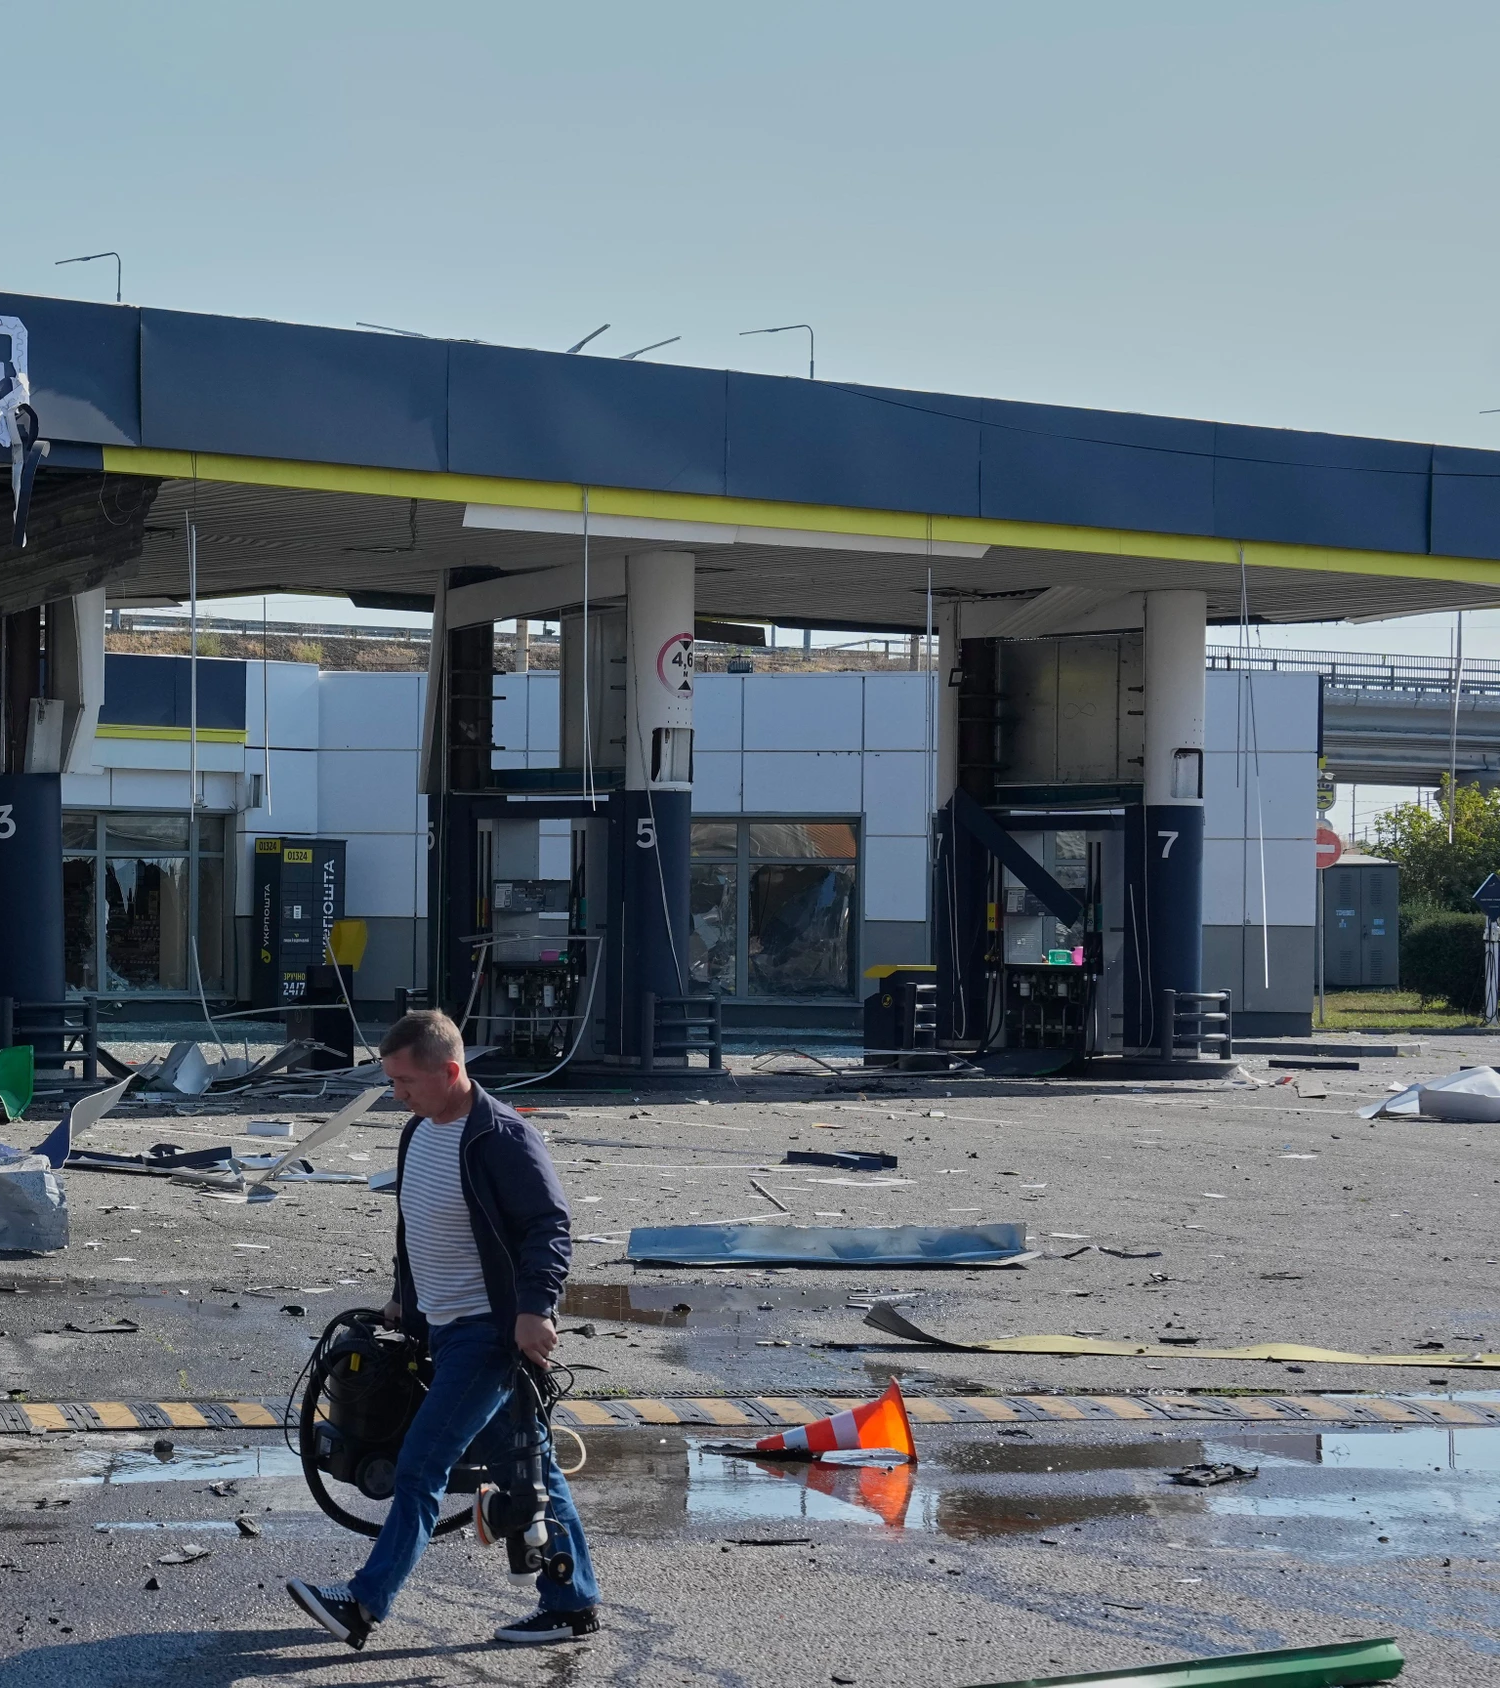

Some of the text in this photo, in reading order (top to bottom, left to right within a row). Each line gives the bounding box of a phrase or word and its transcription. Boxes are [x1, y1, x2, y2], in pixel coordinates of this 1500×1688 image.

[671, 651, 693, 669] 4,6
[636, 818, 656, 848] 5
[259, 842, 276, 851] 01324
[936, 833, 943, 859] 7
[1157, 831, 1179, 858] 7
[287, 851, 308, 861] 01324
[263, 883, 271, 947] УКРПОШТА
[283, 972, 305, 981] ЗРУЧНО
[283, 982, 306, 995] 24/7
